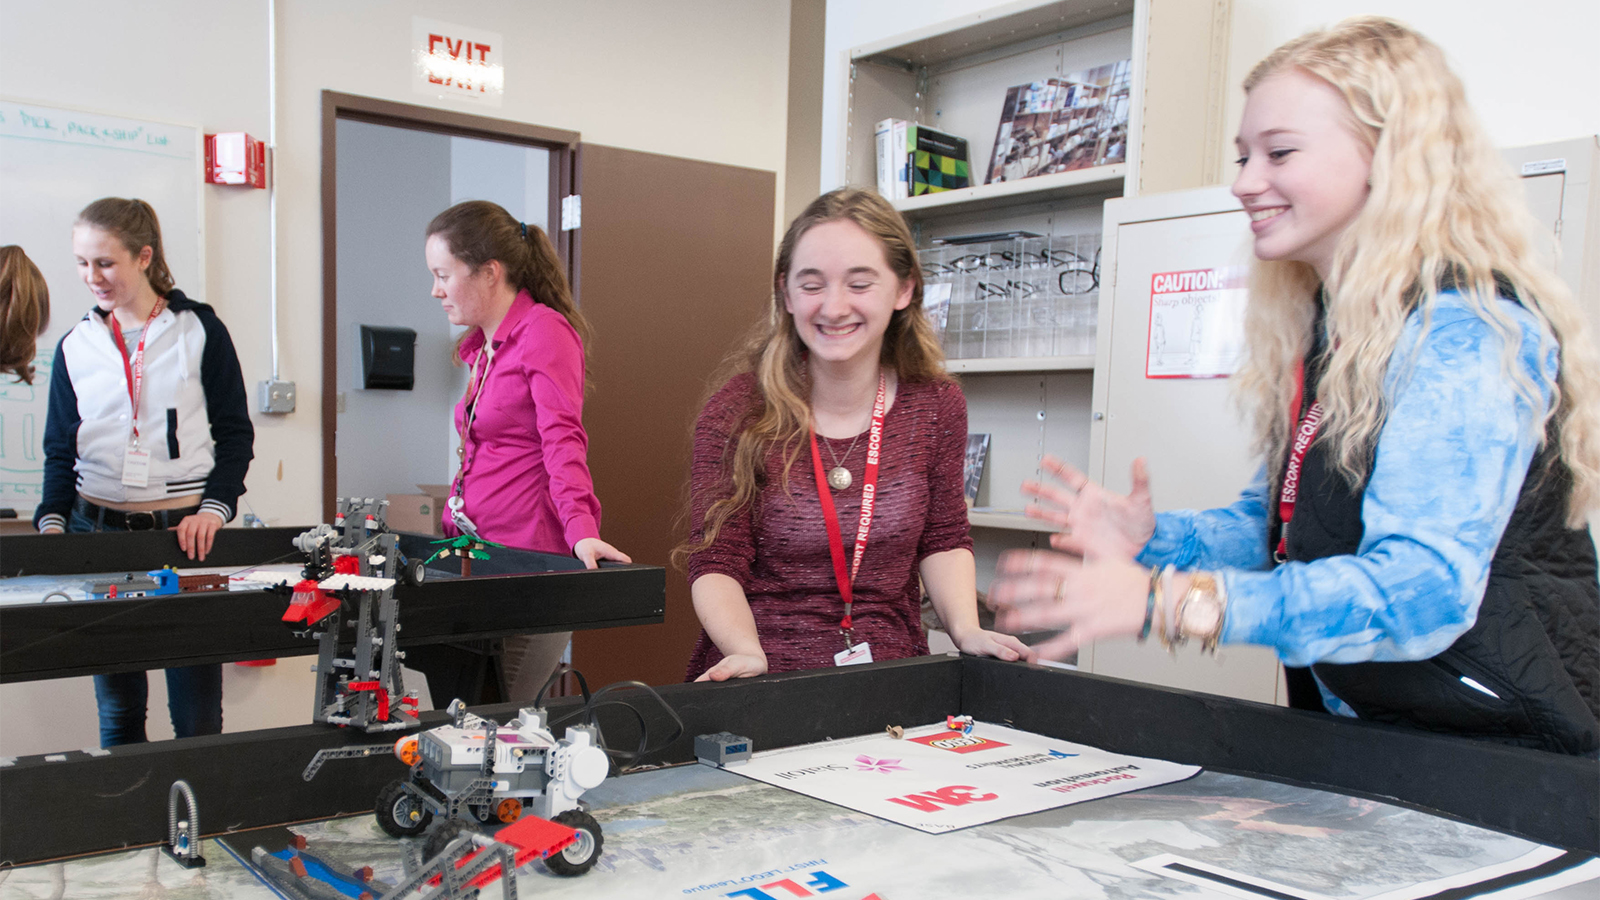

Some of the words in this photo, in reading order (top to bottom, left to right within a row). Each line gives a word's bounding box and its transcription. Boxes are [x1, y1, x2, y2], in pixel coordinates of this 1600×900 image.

[1154, 297, 1179, 308] Sharp
[867, 415, 883, 466] ESCORT
[1281, 452, 1301, 503] ESCORT
[856, 483, 875, 542] REQUIRED
[774, 763, 849, 781] Statoil
[1033, 764, 1141, 788] Automation
[1050, 773, 1138, 794] Rockwell
[885, 785, 999, 813] 3M
[682, 878, 738, 895] League
